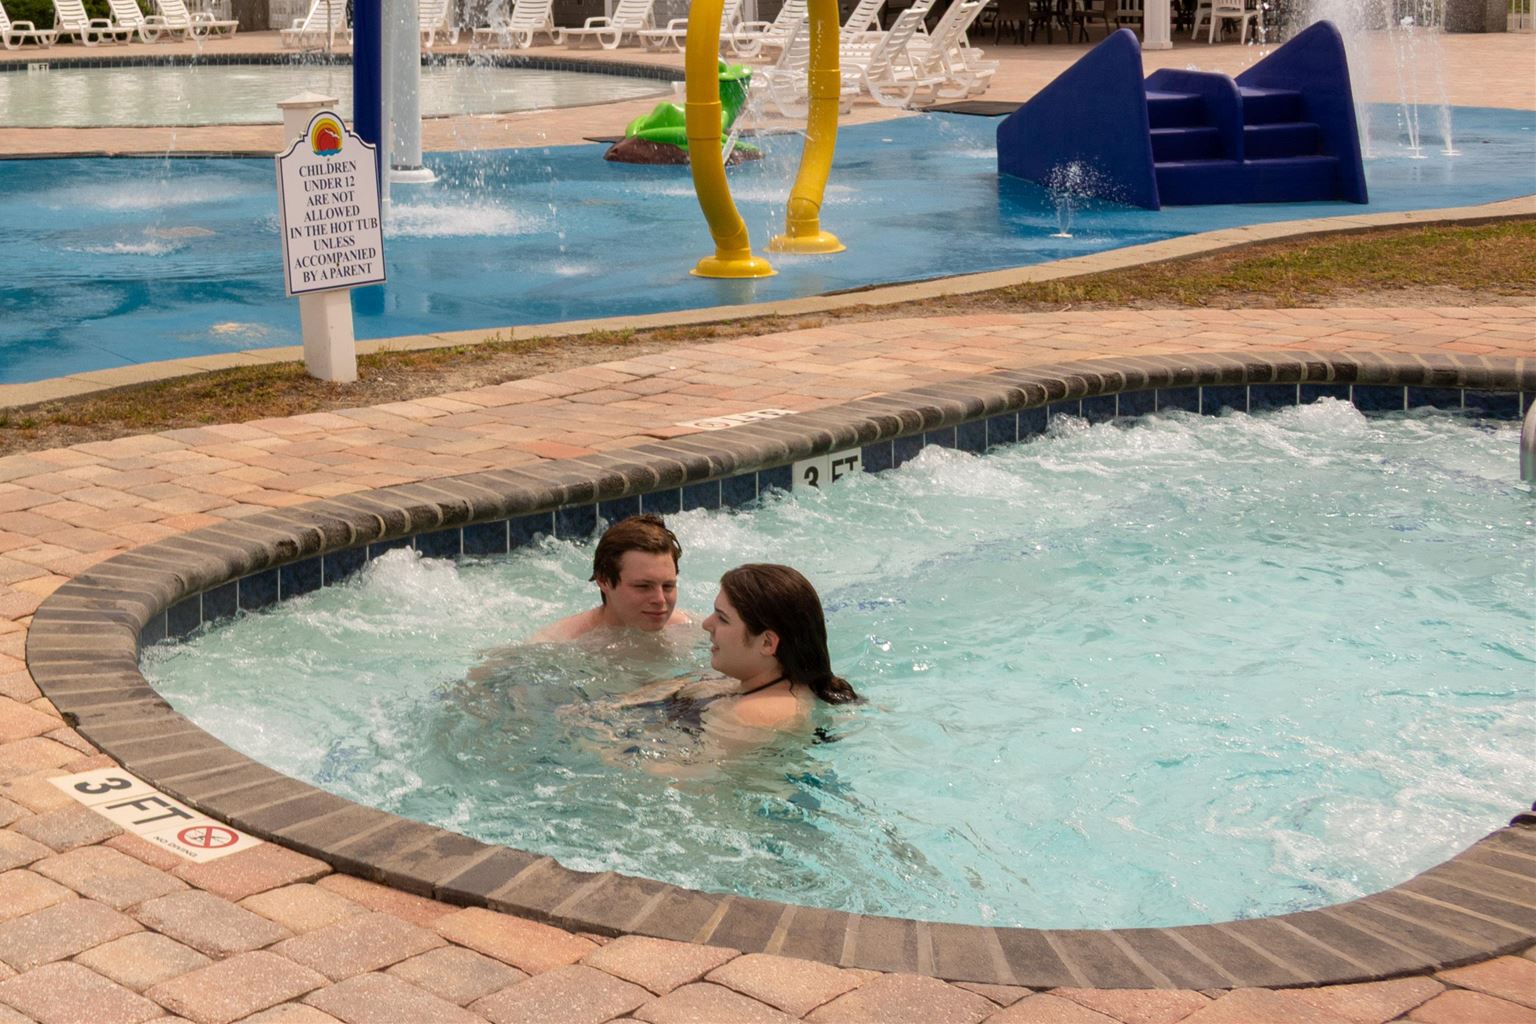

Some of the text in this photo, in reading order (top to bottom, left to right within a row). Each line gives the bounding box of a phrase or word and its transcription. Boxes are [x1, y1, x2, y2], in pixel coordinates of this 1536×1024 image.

[298, 160, 357, 178] CHILDREN
[304, 175, 355, 192] UNDER 12
[307, 190, 355, 207] ARE NOT
[304, 204, 360, 223] ALLOWED
[290, 217, 378, 239] IN THE HOT TUB
[313, 235, 356, 251] UNLESS
[295, 247, 376, 269] ACCOMPANIED
[303, 262, 373, 283] BY A PARENT
[832, 455, 858, 483] FT
[74, 777, 195, 825] 3 FT
